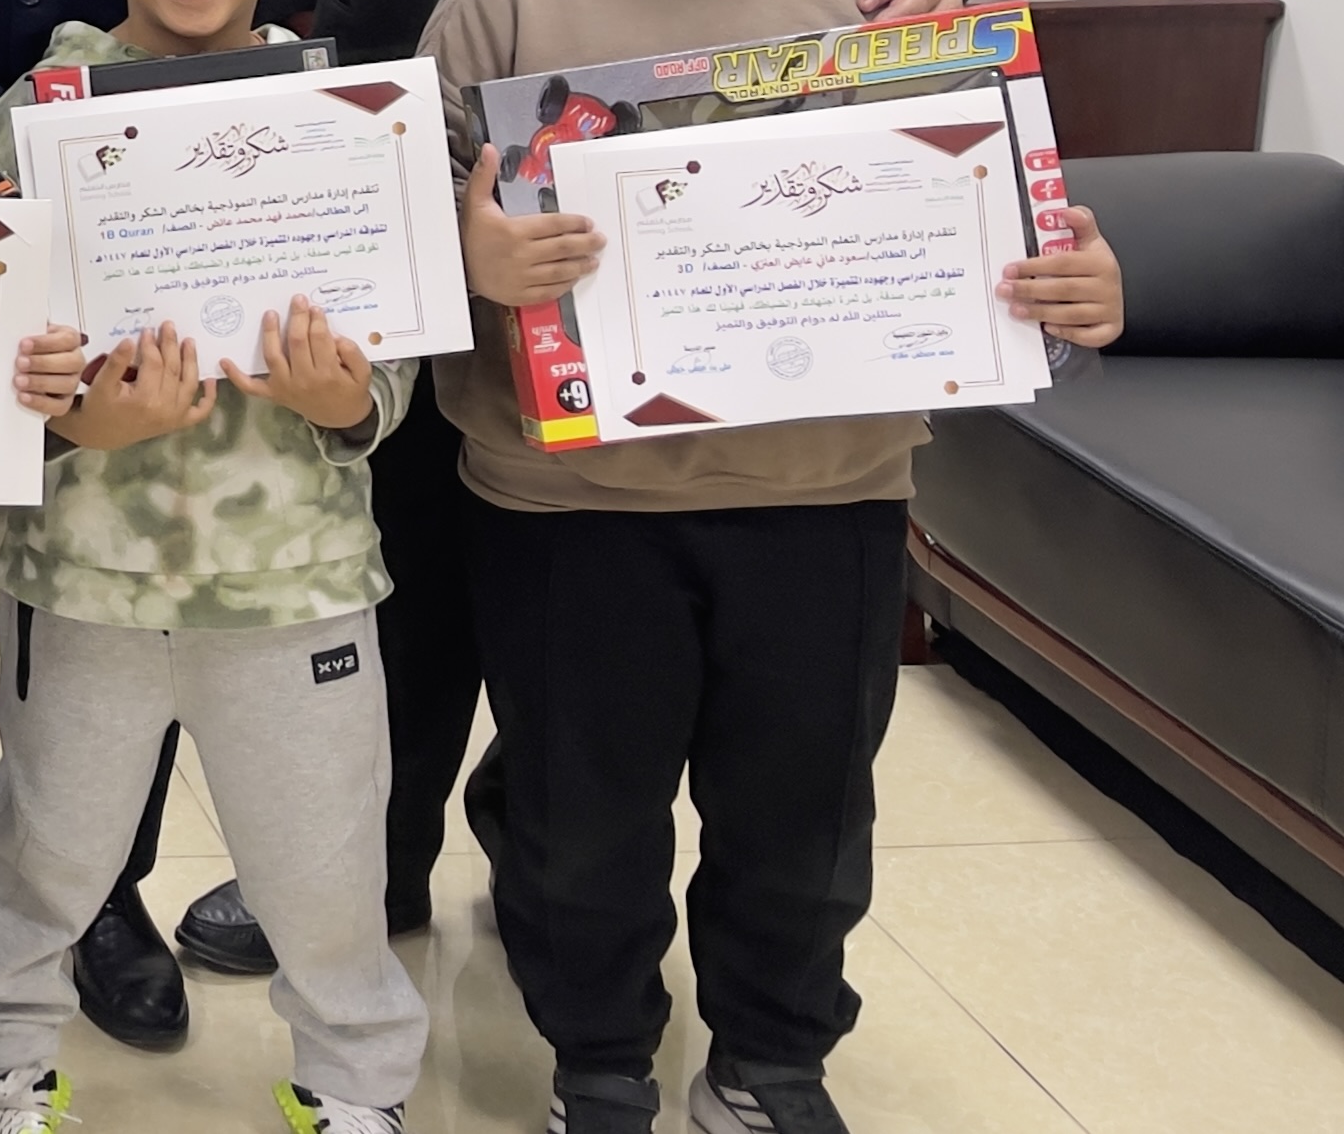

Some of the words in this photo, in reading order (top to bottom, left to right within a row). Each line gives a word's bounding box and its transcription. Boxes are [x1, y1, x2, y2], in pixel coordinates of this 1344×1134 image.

[837, 10, 1023, 74] SPEED
[715, 41, 822, 90] CAR
[812, 72, 854, 89] RADIO
[730, 83, 800, 99] CONTROL
[232, 126, 288, 178] شكر
[802, 166, 863, 218] شكر
[117, 227, 154, 239] Quran
[550, 361, 586, 377] AGES
[317, 654, 355, 674] XYZ
